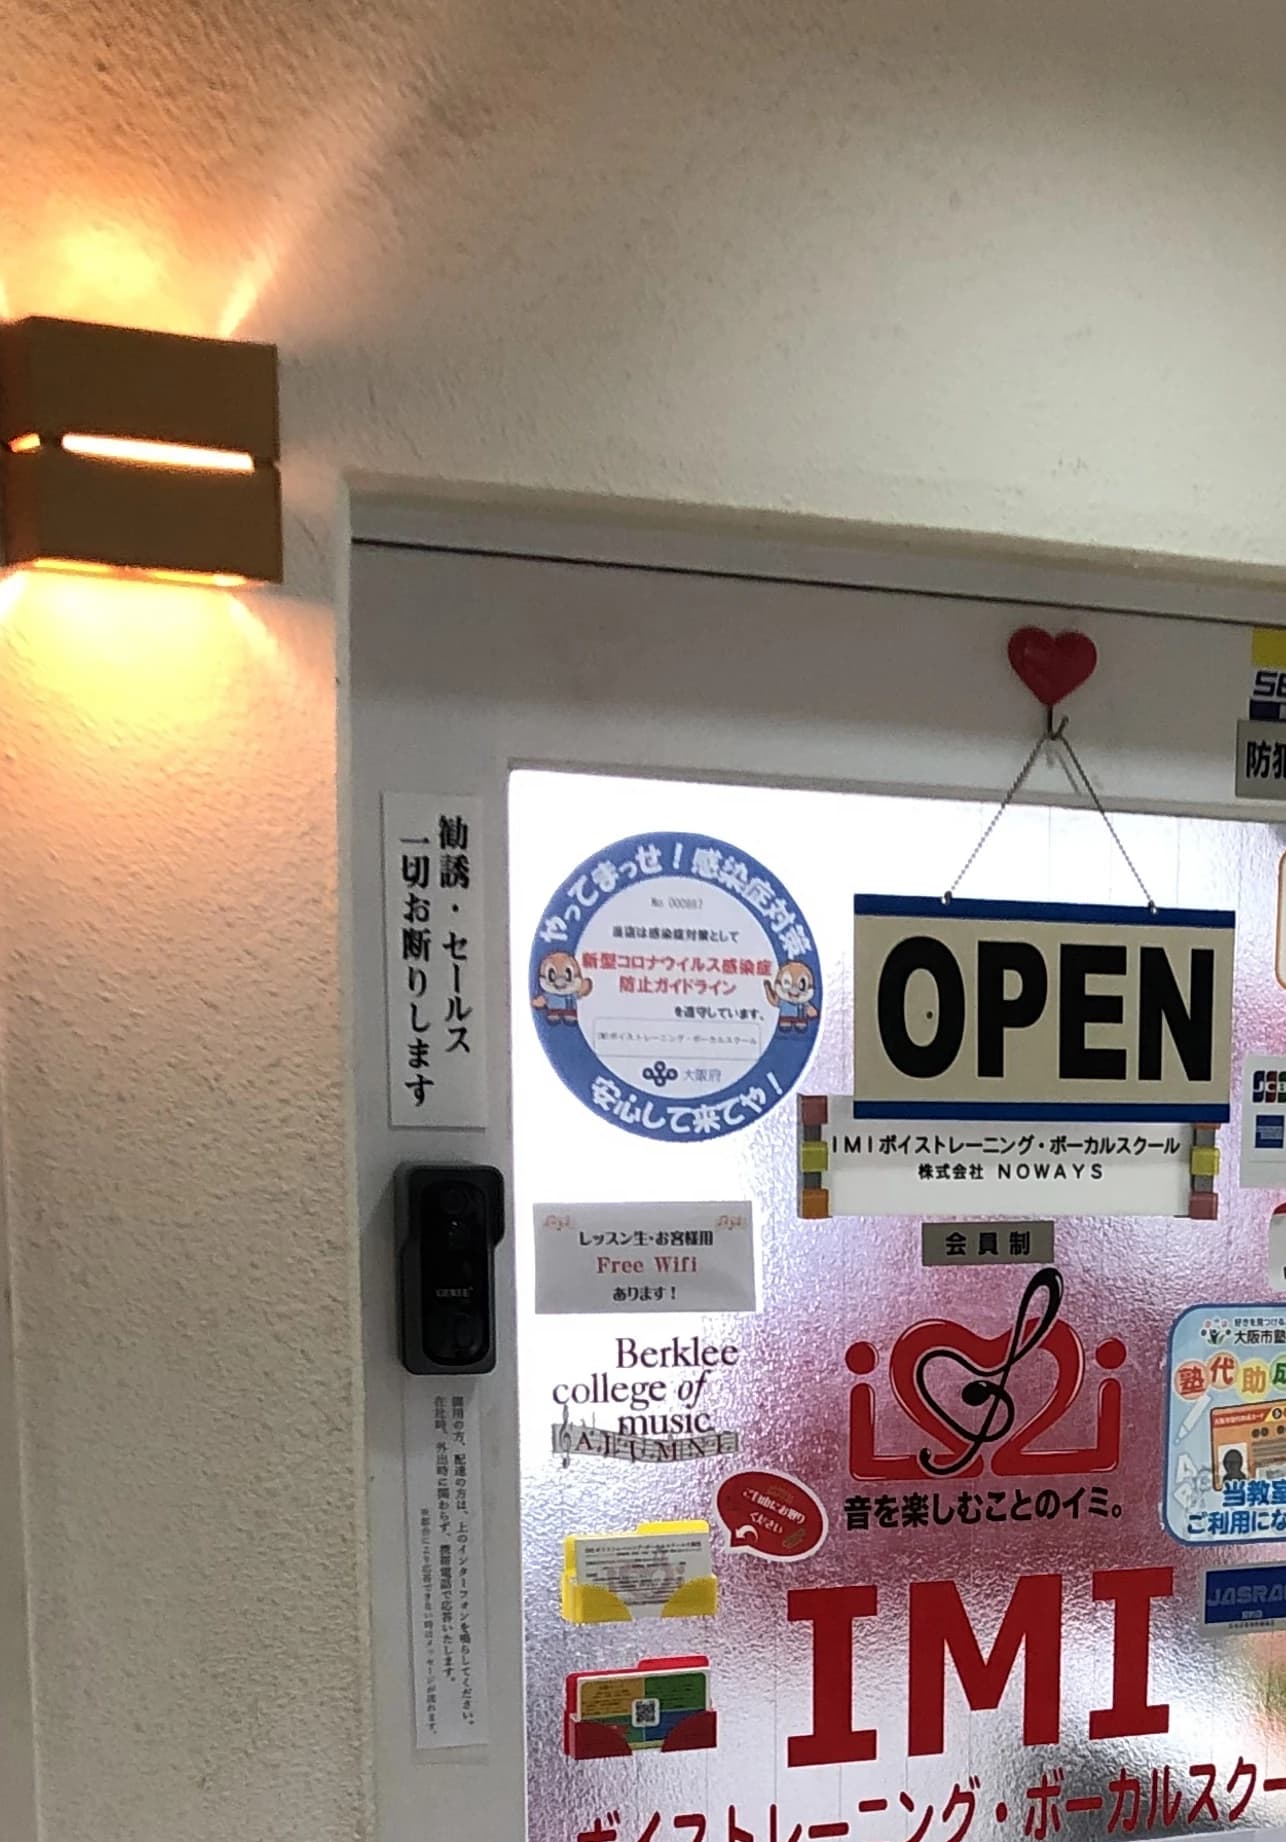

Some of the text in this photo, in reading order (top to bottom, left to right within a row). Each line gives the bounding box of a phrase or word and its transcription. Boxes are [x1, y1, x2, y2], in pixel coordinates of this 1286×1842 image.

[438, 815, 472, 1054] 勧誘・セールス
[400, 836, 434, 1107] 一切お断りします
[581, 952, 773, 976] 新型コロナウイルス感染症
[619, 975, 737, 996] 防止ガイドライン
[876, 935, 1216, 1082] OPEN
[590, 1073, 785, 1134] 安心して来てや！
[917, 1163, 1104, 1182] 株式会社 NOWAYS
[945, 1231, 1031, 1255] 会員制
[596, 1255, 698, 1274] Free Wifi
[612, 1286, 677, 1301] あります！
[615, 1336, 739, 1369] Berklee
[552, 1368, 713, 1411] college of
[618, 1410, 714, 1437] music
[574, 1430, 730, 1463] ALUMNI
[844, 1486, 1122, 1531] 音を楽しむことのイミ。
[786, 1566, 1174, 1768] IMI
